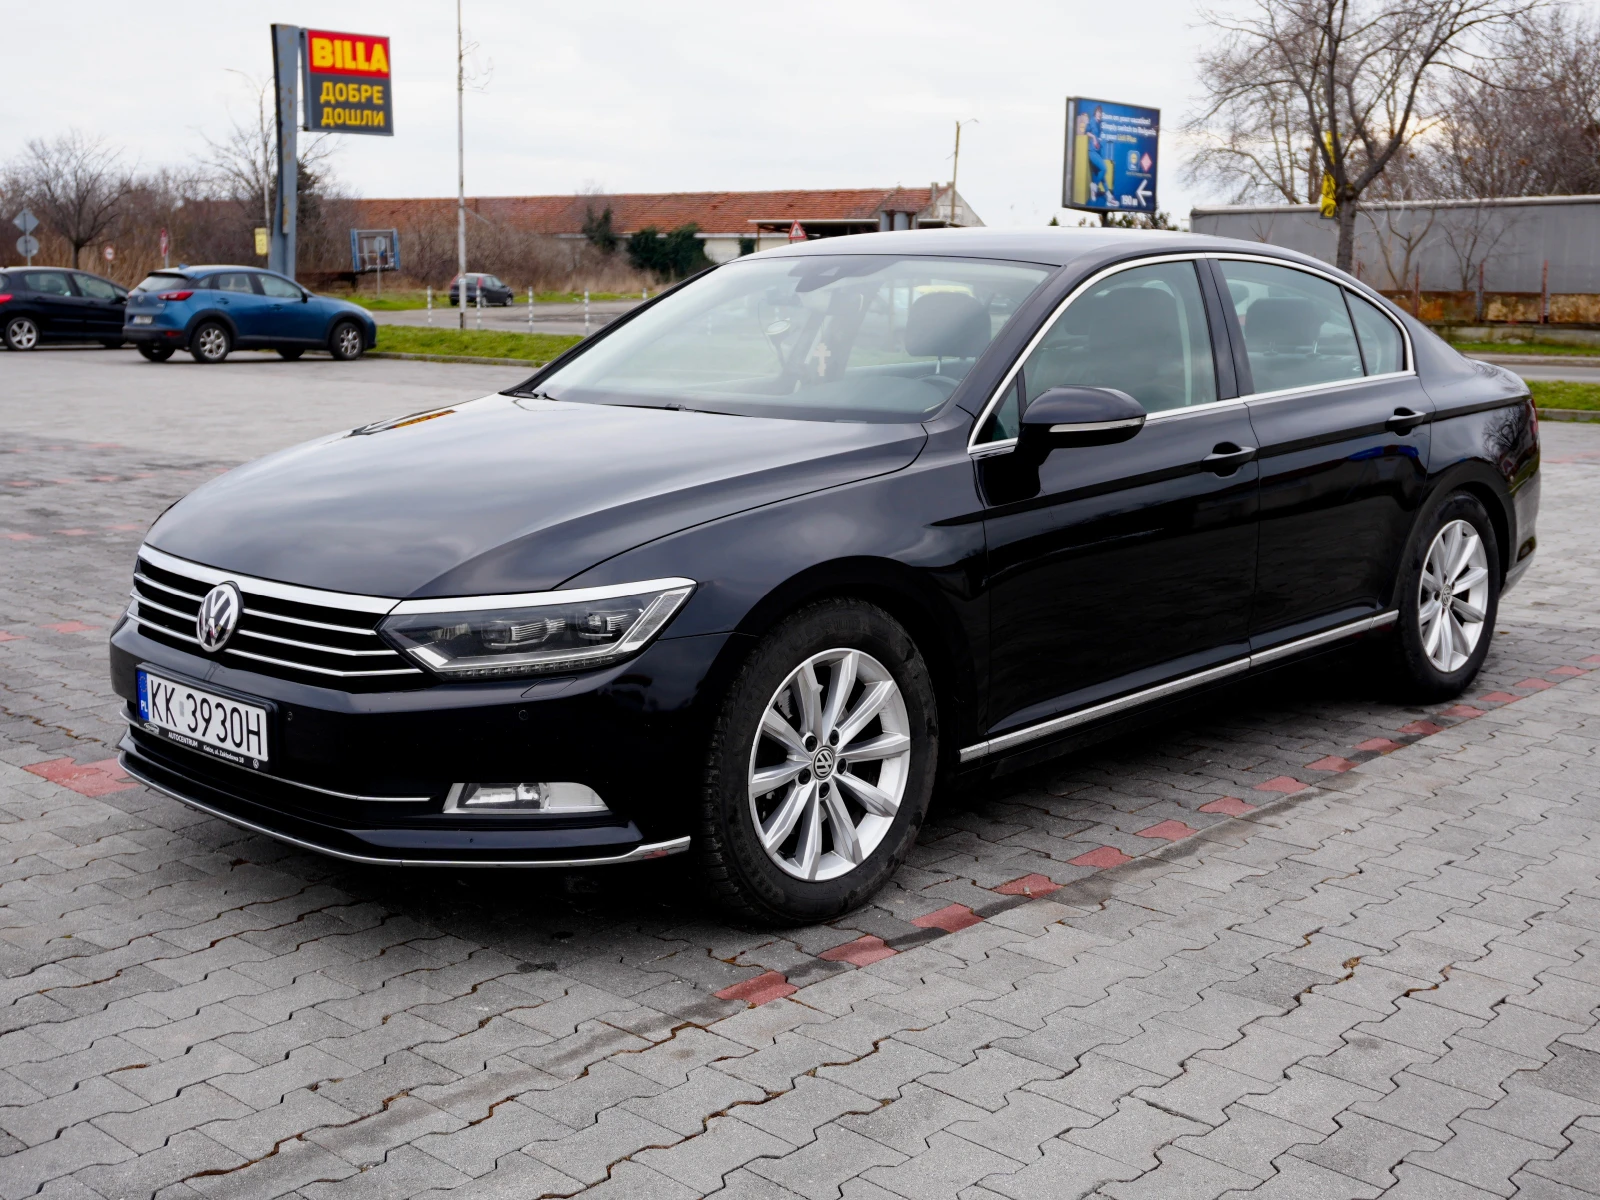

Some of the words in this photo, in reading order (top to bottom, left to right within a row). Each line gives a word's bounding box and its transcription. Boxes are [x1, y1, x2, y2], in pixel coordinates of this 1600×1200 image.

[311, 37, 389, 73] BILLA
[320, 81, 384, 104] ДОБРЕ
[321, 107, 384, 127] ДОШЛИ
[140, 699, 148, 712] PL
[150, 679, 177, 728] KK
[186, 692, 262, 756] 3930H
[168, 731, 198, 748] AUTOCENTRUM
